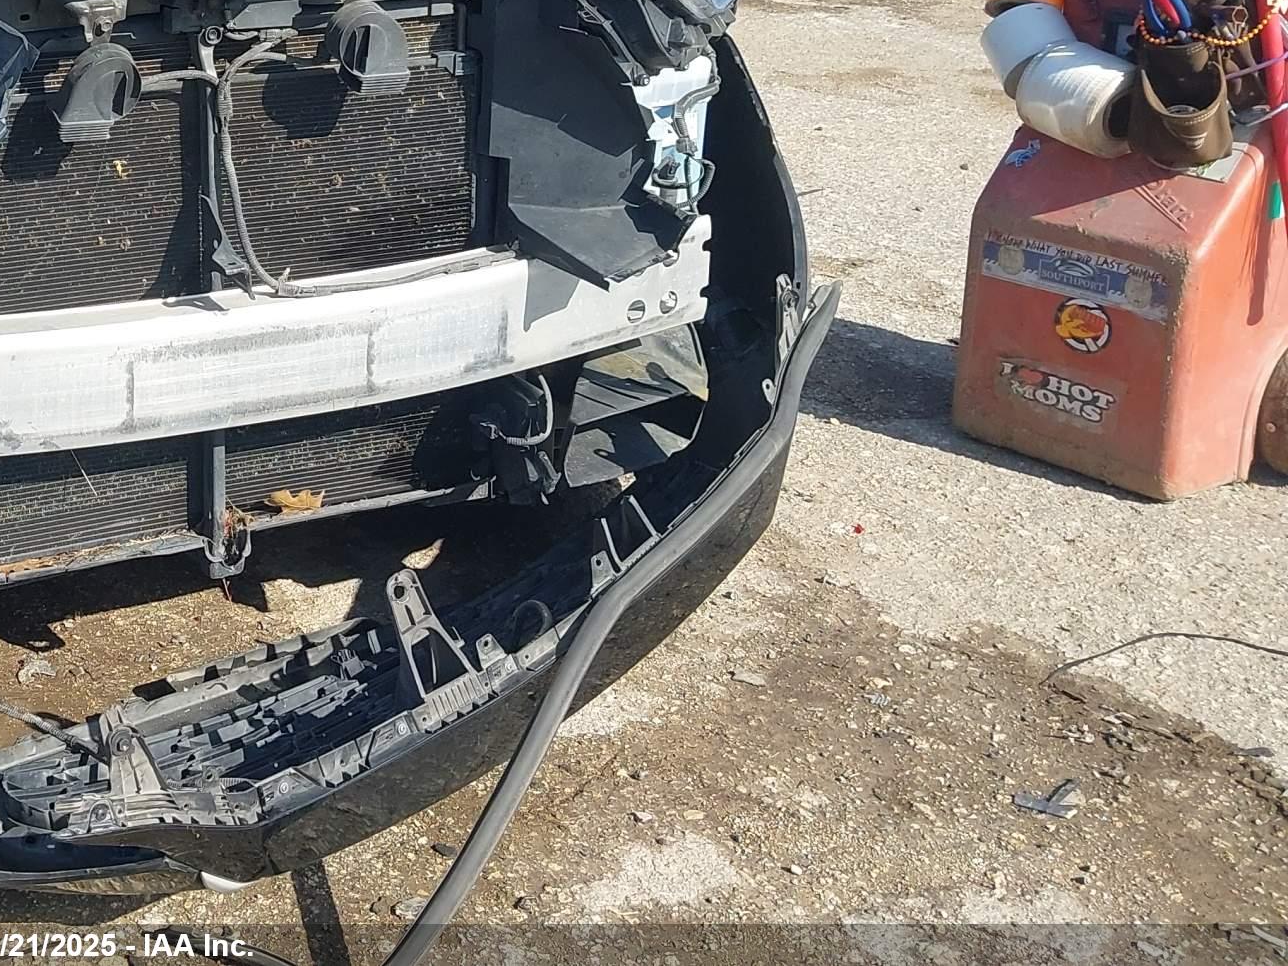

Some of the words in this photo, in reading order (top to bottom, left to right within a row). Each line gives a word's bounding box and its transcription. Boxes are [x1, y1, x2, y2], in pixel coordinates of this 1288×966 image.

[1024, 239, 1051, 254] WHAT
[1055, 247, 1074, 260] YOU
[1096, 256, 1123, 272] LAST
[1042, 268, 1104, 291] SOUTHPORT
[1010, 379, 1103, 423] MOMS
[1045, 375, 1116, 410] HOT
